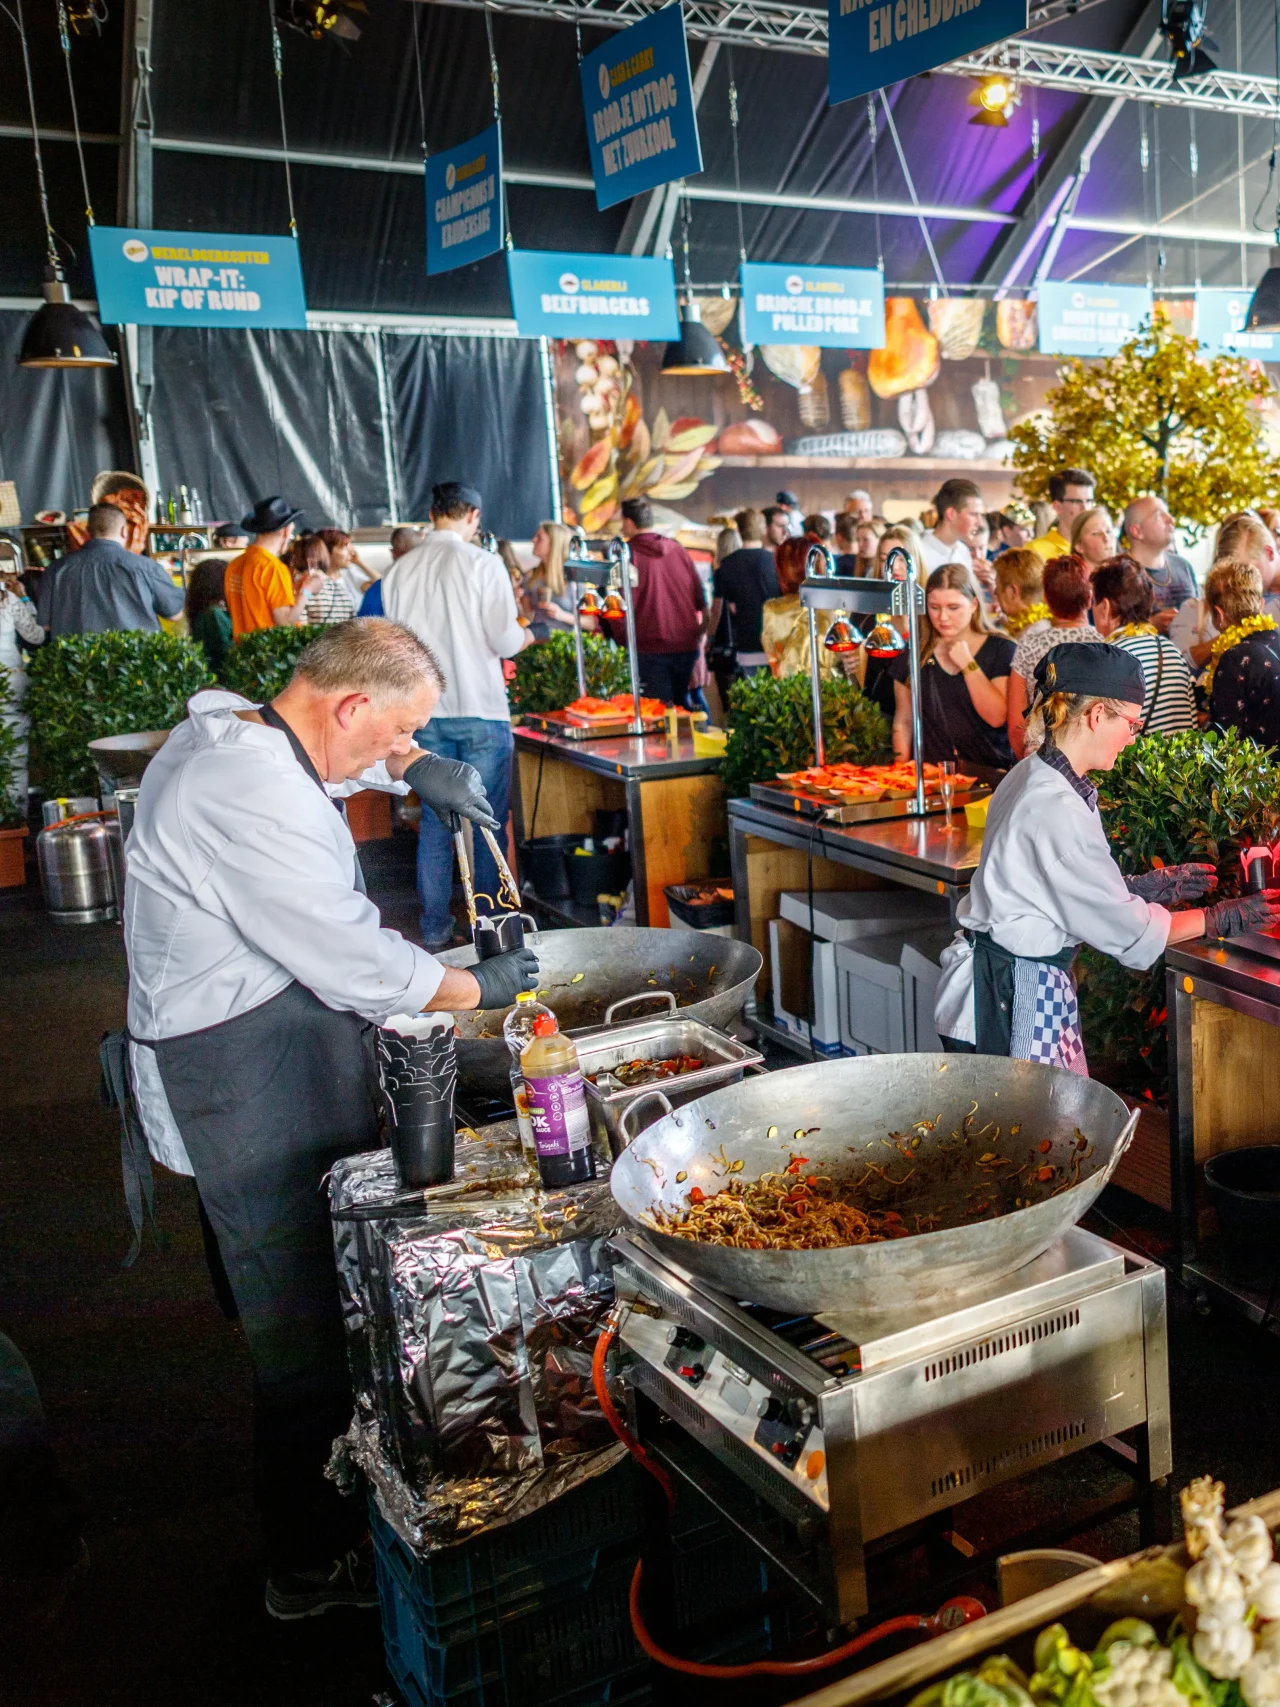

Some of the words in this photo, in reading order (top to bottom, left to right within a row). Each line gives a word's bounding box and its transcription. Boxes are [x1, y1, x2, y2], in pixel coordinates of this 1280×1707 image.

[869, 4, 892, 53] EN
[593, 94, 633, 144] BROODJE
[631, 73, 677, 123] HOTDOG
[602, 139, 623, 177] MET
[622, 116, 676, 168] ZUURKOOL
[154, 266, 246, 289] WRAP-IT:
[144, 287, 179, 308] KIP
[181, 288, 204, 310] OF
[207, 290, 261, 312] RUND
[540, 294, 650, 316] BEEFBURGERS
[772, 313, 822, 332] PULLED
[825, 316, 859, 334] PORK
